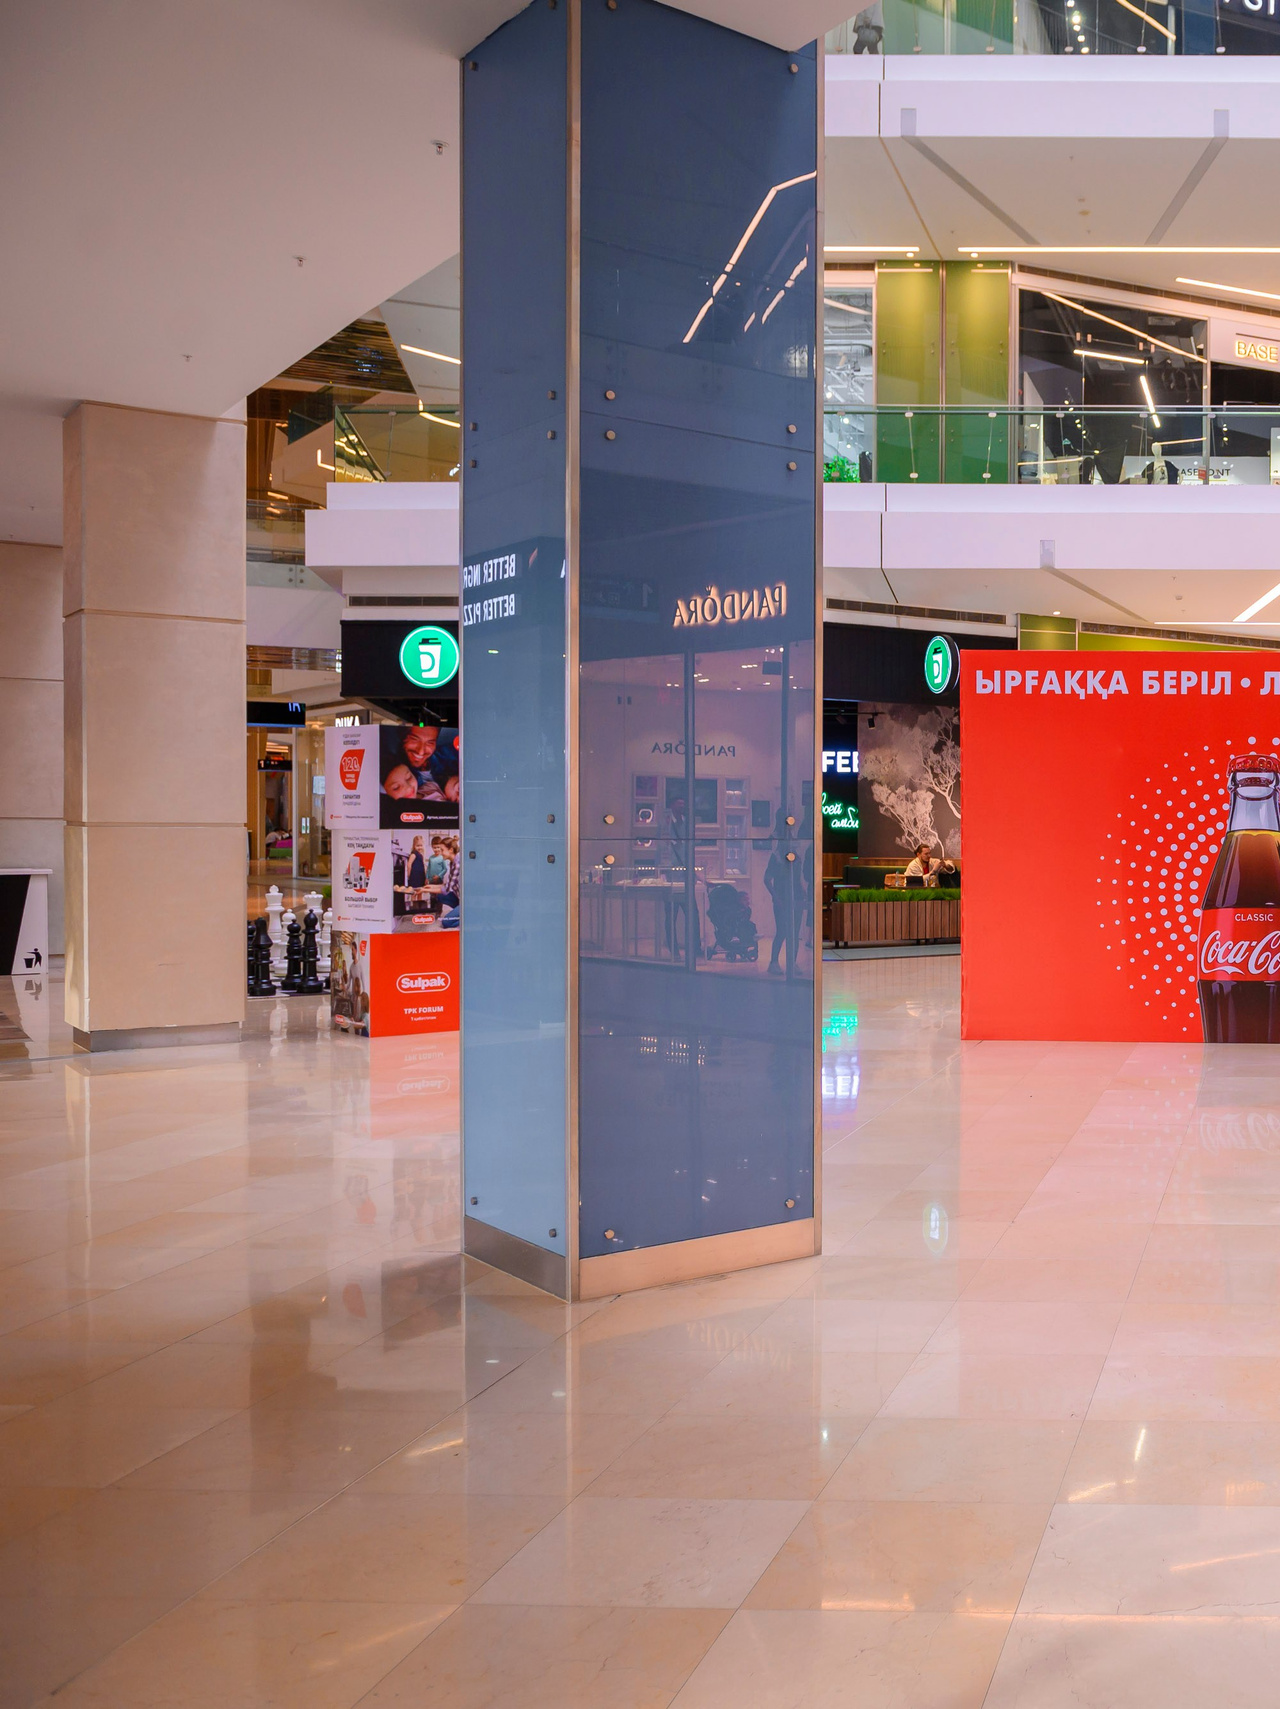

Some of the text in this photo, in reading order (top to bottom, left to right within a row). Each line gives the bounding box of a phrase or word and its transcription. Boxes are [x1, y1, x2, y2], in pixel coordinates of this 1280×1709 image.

[1235, 341, 1279, 363] BASE
[975, 670, 1128, 699] ЫРҒАҚҚА
[1143, 670, 1232, 696] БЕРІЛ
[1235, 913, 1274, 922] CLASSIC
[401, 976, 445, 990] Sulpak
